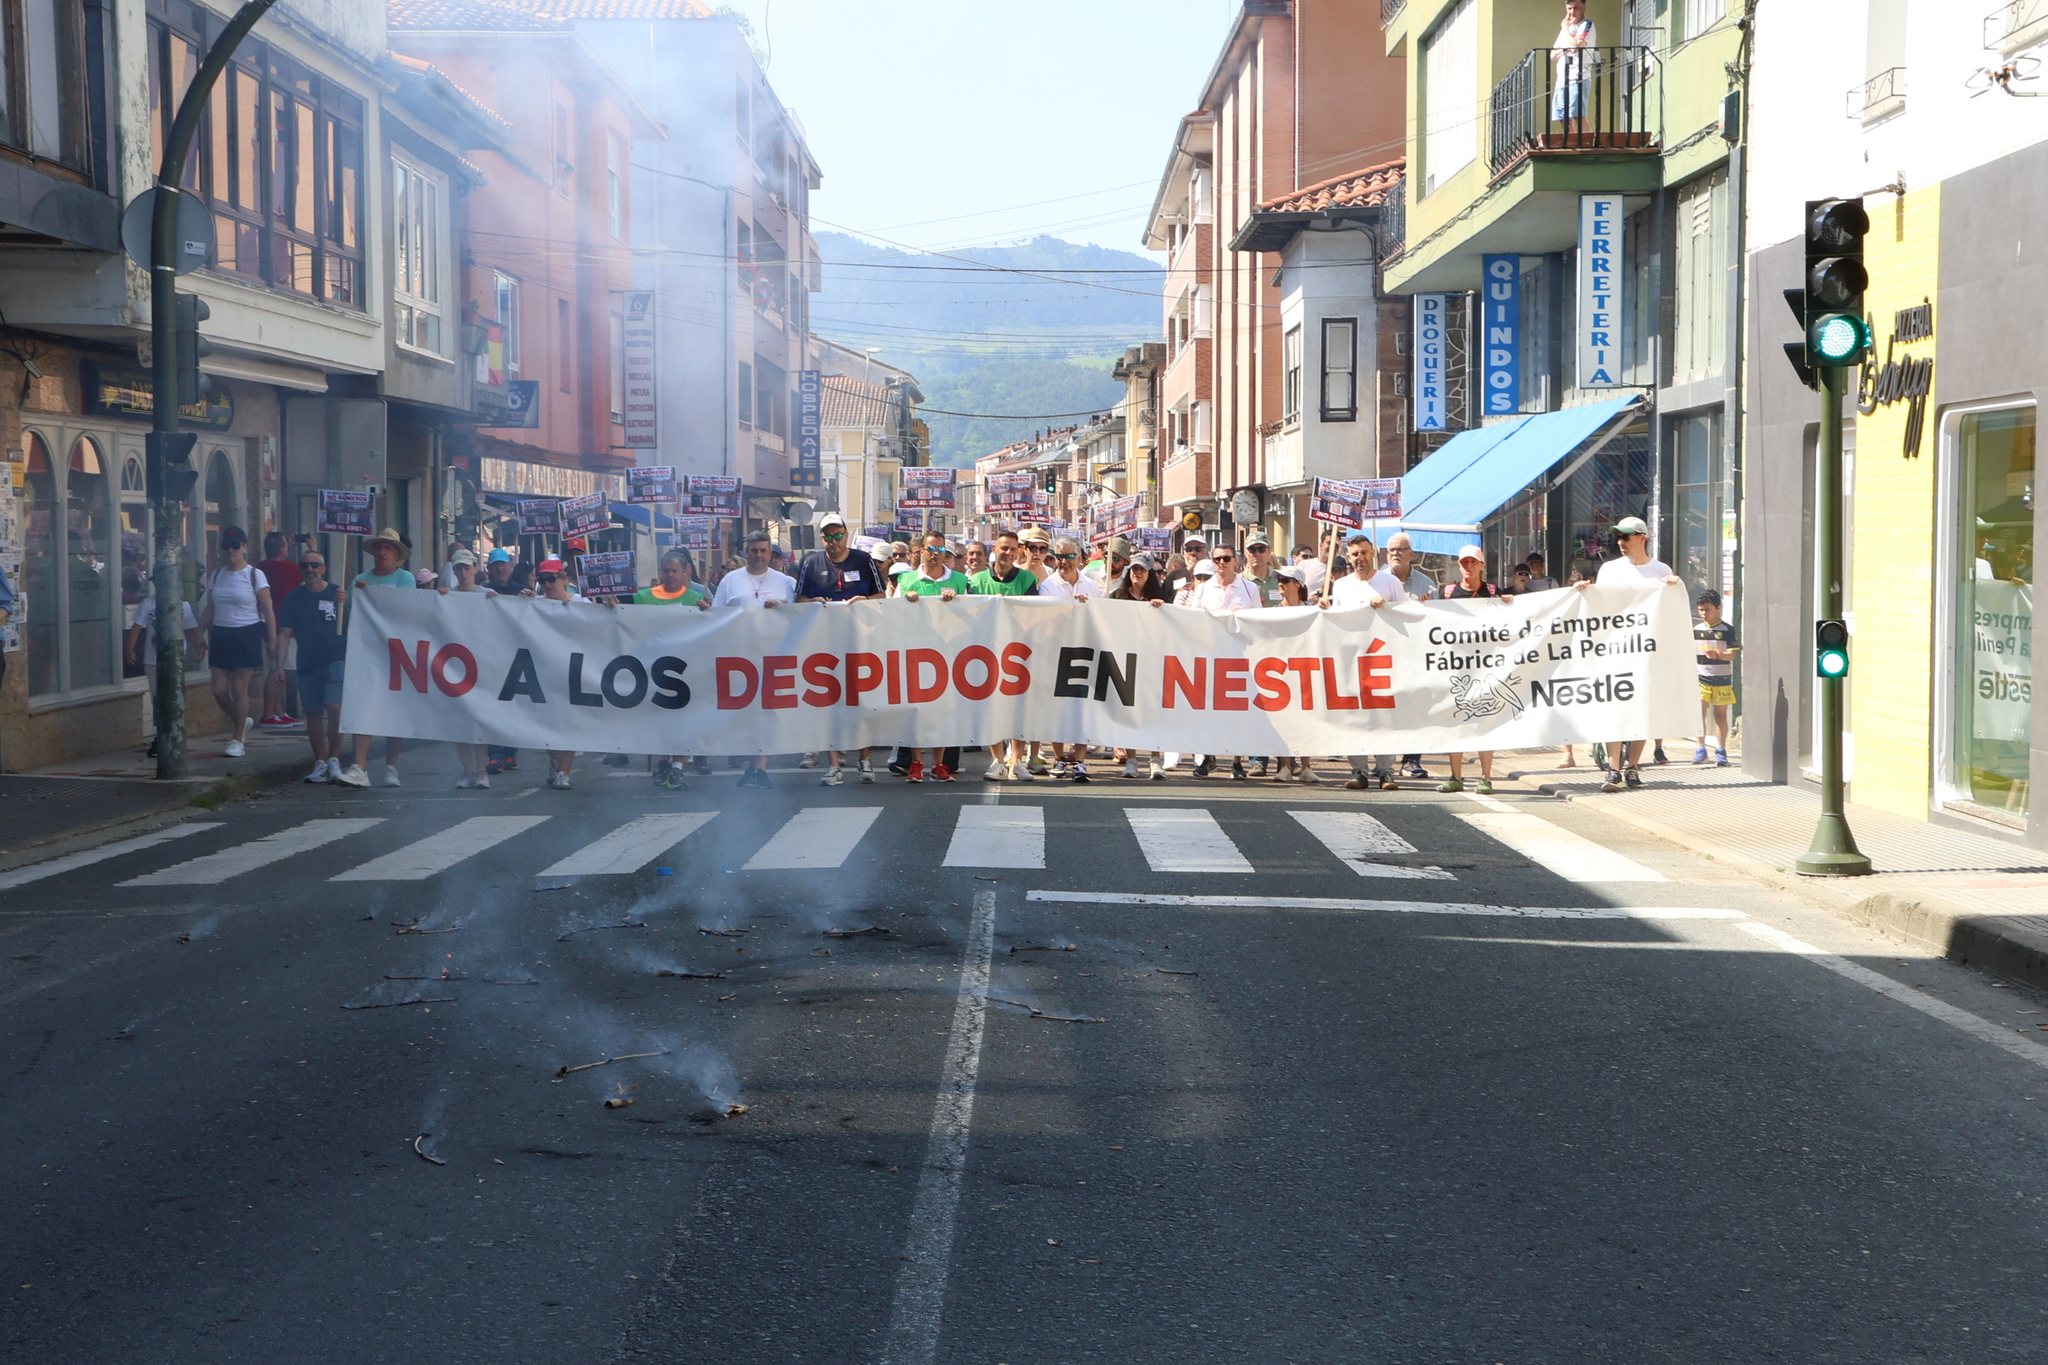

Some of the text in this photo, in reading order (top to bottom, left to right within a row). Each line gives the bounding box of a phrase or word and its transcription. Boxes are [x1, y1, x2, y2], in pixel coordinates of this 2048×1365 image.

[1589, 201, 1613, 384] FERRETERIA
[1422, 299, 1439, 428] DROGUERIA
[1489, 260, 1514, 412] QUINDOS
[628, 436, 654, 444] MAQUINARIA
[801, 372, 818, 469] HOSPEDAJE
[1338, 517, 1353, 525] ERE!
[1426, 633, 1656, 670] Fábrica de La Penilla
[1428, 612, 1648, 646] Comité de Empresa
[387, 638, 1396, 712] NO A LOS DESPIDOS EN NESTLÉ
